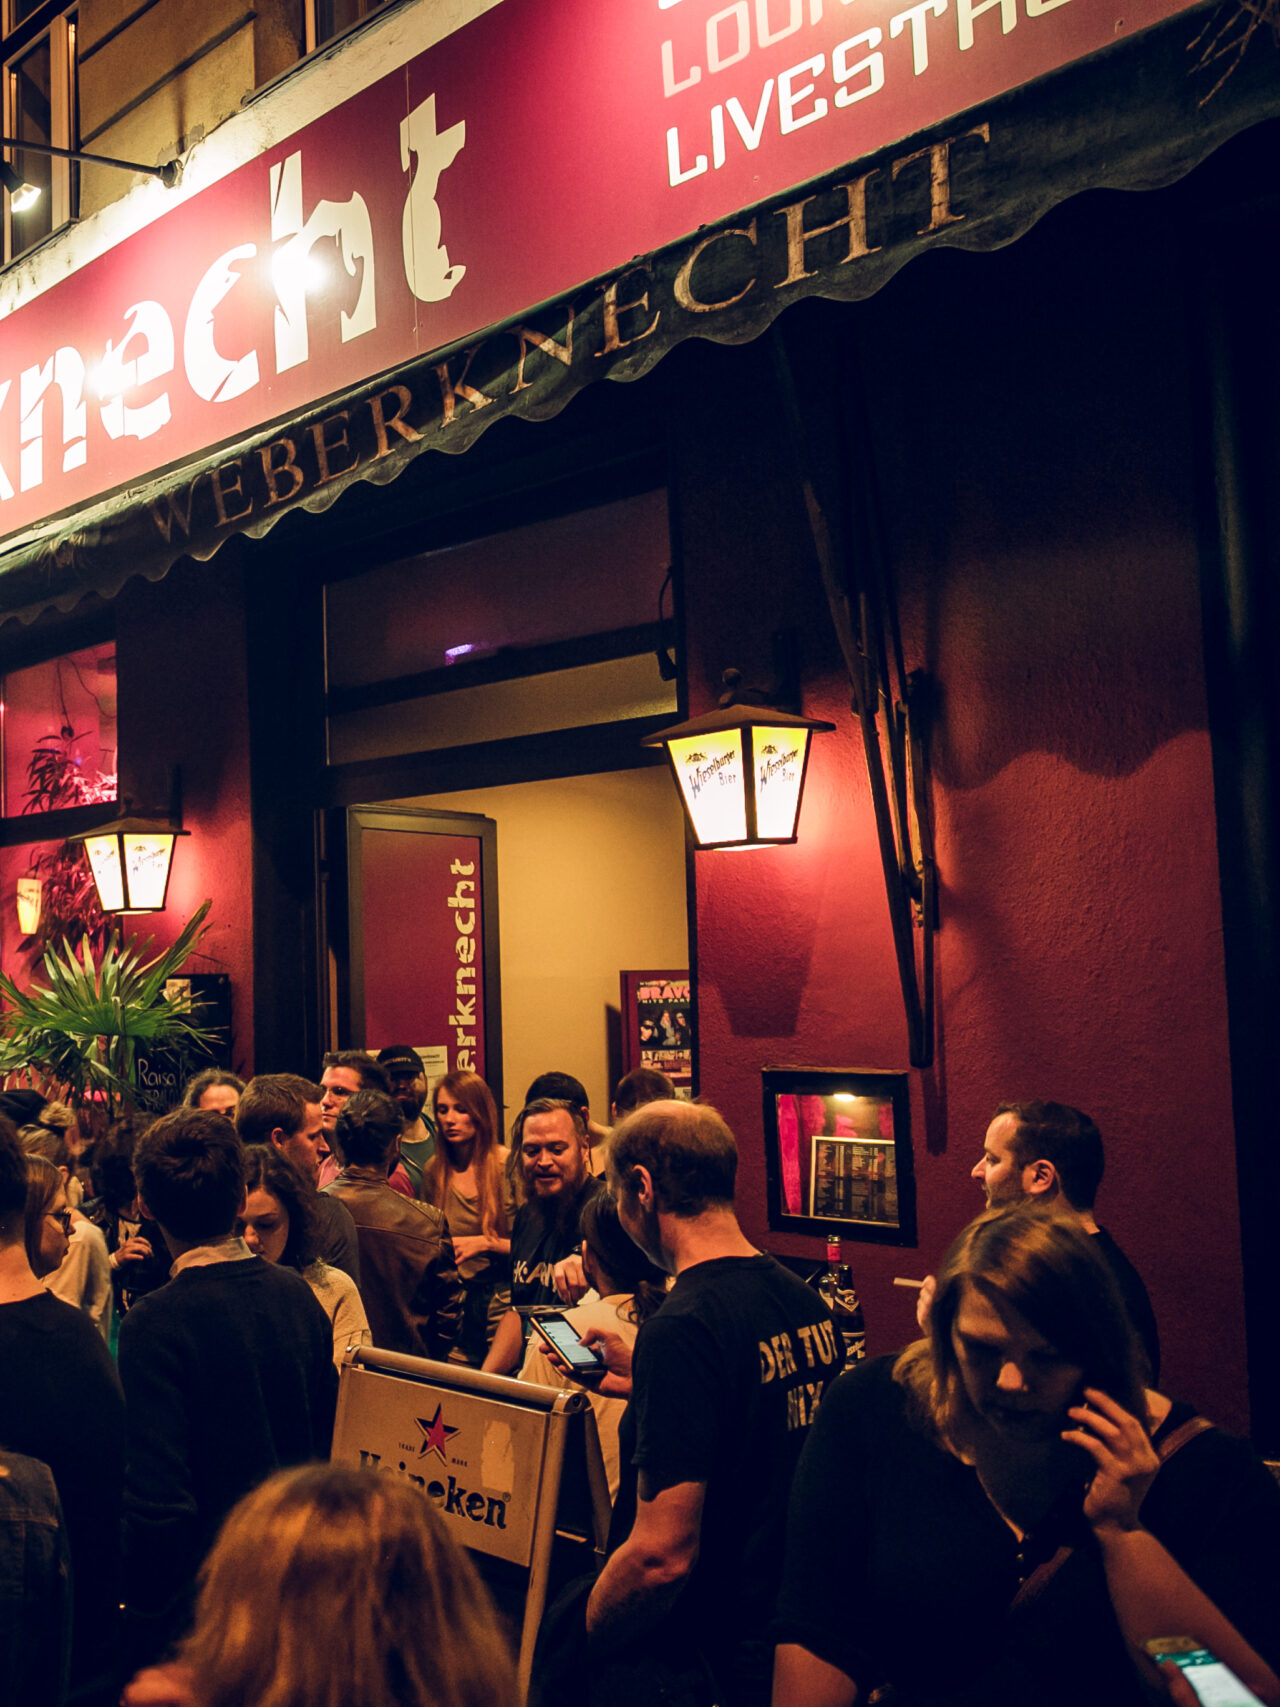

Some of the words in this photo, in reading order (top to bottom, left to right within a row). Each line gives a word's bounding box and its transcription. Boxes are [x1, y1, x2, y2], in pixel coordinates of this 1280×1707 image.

[660, 0, 824, 99] LOU
[148, 122, 991, 544] WEBERKNECHT
[718, 771, 737, 786] Bier
[758, 1331, 798, 1384] DER
[360, 1449, 508, 1530] Heken
